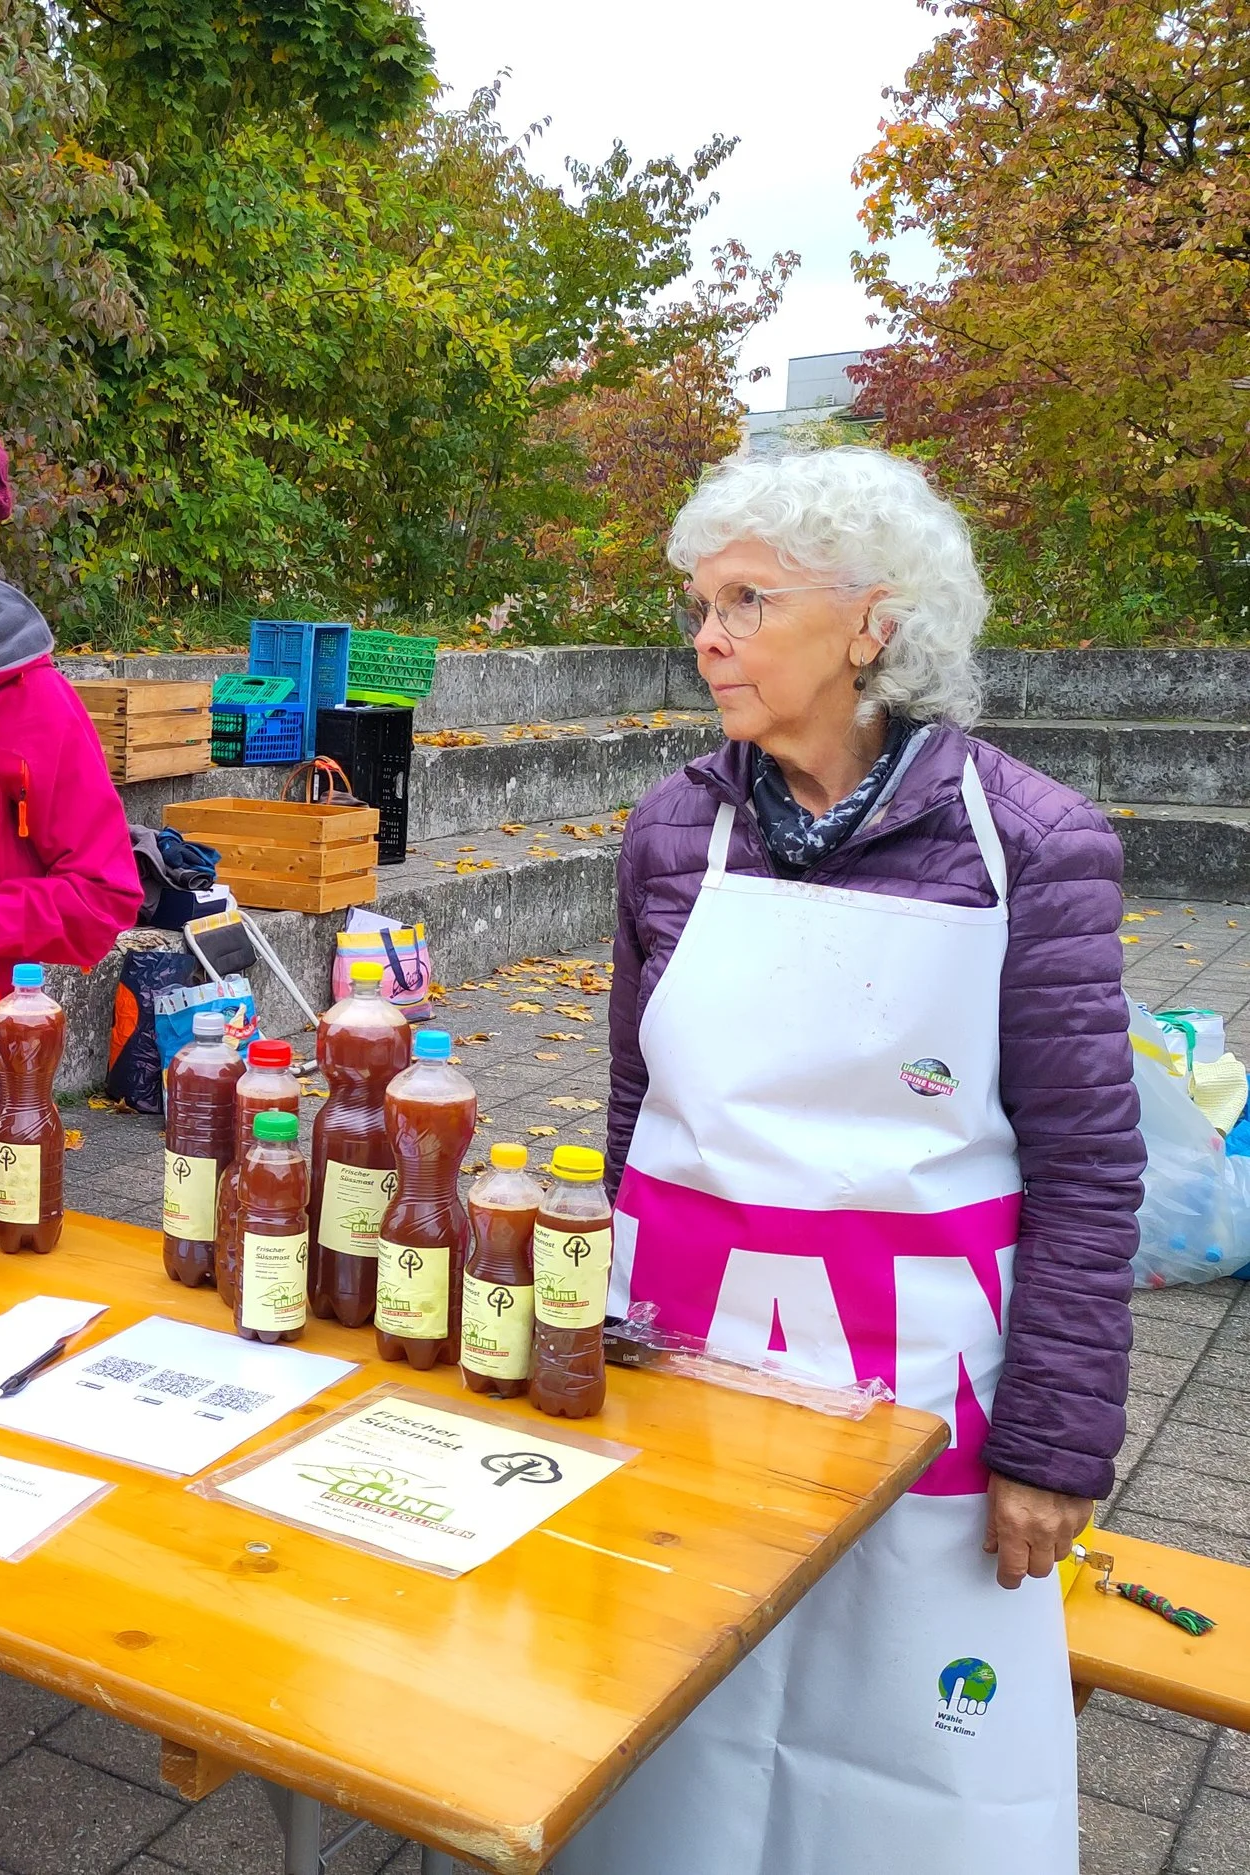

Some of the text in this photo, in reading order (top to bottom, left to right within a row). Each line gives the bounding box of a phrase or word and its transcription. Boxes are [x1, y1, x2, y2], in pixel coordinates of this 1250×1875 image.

[902, 1073, 952, 1096] DEINE WAHL
[903, 1064, 958, 1088] UNSER KLIMA
[360, 1416, 464, 1452] Süssmost
[372, 1410, 462, 1438] Frischer
[320, 1492, 356, 1508] FREIE
[358, 1501, 394, 1518] LISTE
[393, 1510, 476, 1539] ZOLLIKOFEN
[934, 1720, 976, 1737] fürs Klima
[938, 1712, 963, 1724] Wähle
